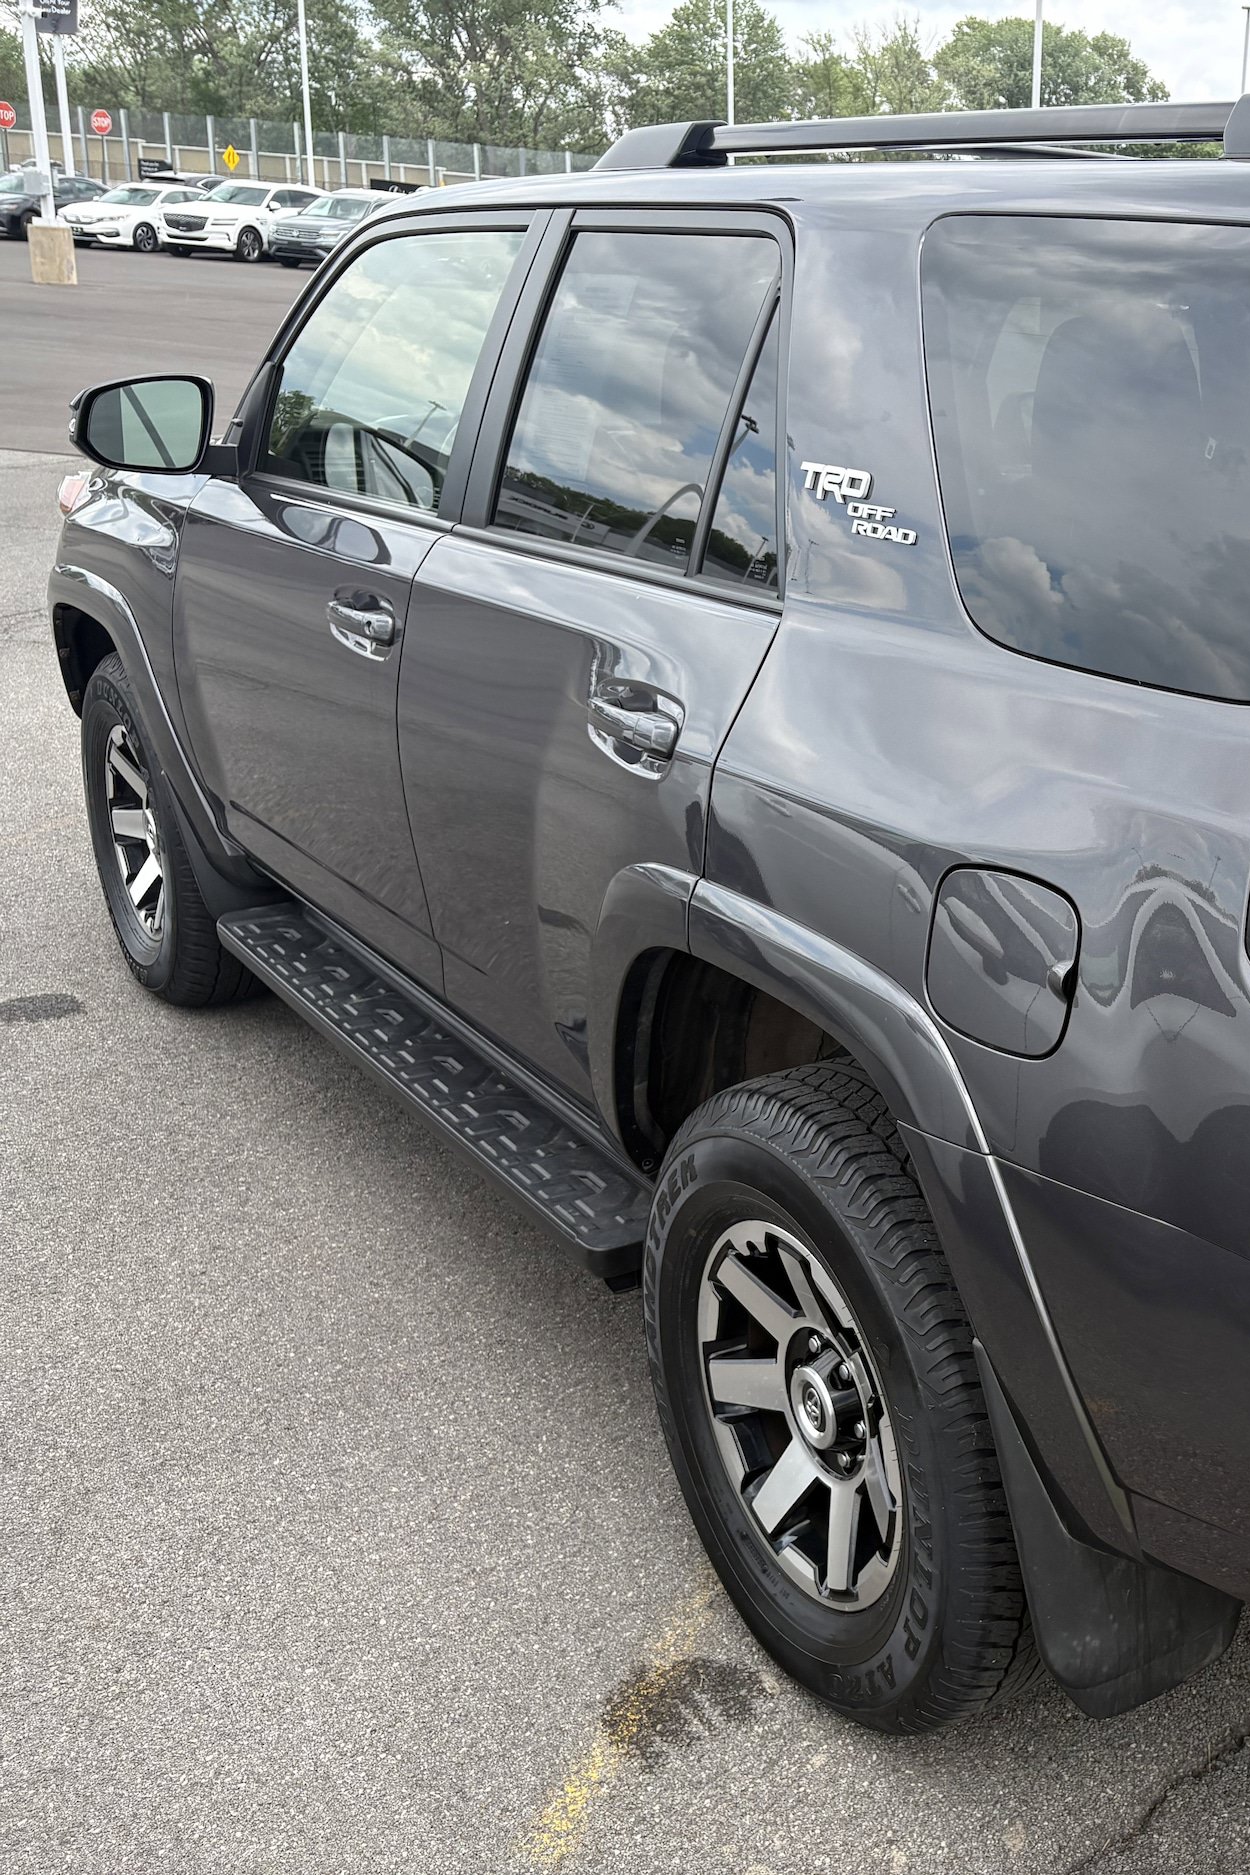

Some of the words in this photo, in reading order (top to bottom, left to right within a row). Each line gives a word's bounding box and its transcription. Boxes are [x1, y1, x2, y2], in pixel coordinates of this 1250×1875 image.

[0, 110, 15, 121] TOP
[92, 117, 111, 128] STOP
[800, 461, 873, 504] TRD
[847, 501, 896, 521] OFF
[851, 519, 917, 545] ROAD
[892, 1403, 933, 1662] DUNLOP
